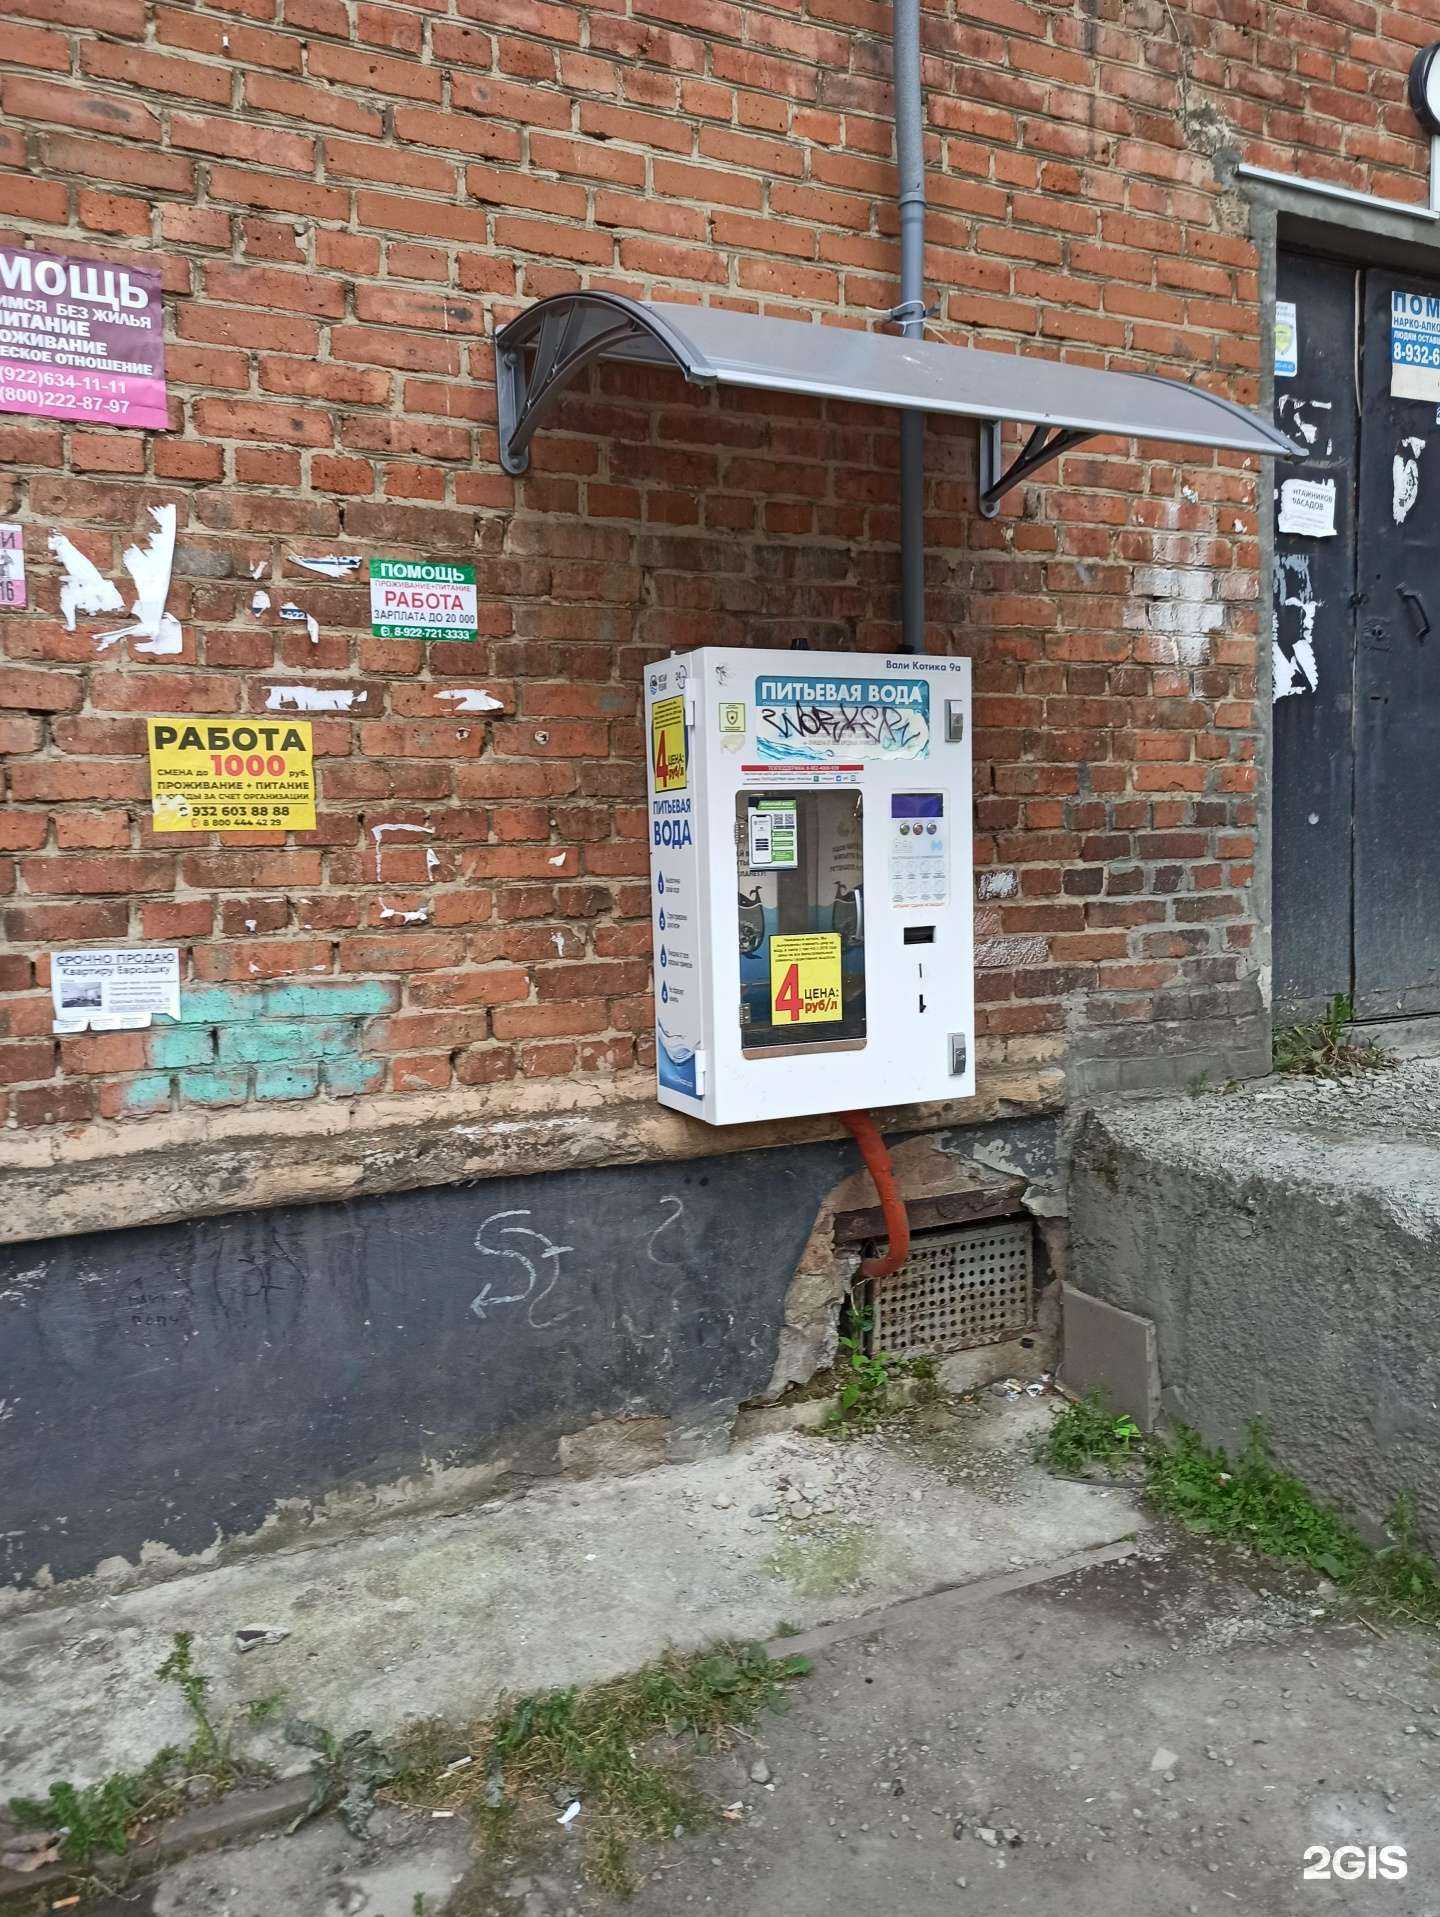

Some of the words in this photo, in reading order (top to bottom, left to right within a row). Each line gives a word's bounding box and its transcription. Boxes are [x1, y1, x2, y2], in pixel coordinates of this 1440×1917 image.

[0, 254, 148, 311] МОЩЬ
[56, 303, 89, 319] БЕЗ
[92, 308, 151, 329] ЖИЛЬЯ
[55, 354, 152, 376] ОТНОШЕНИЕ
[380, 563, 465, 583] ПОМОЩЬ
[385, 590, 464, 610] РАБОТА
[374, 610, 425, 621] ЗАРПЛАТА
[429, 612, 443, 623] ДО
[446, 613, 456, 623] 20
[460, 614, 475, 624] 000
[394, 627, 470, 640] 8-922-721-3333
[886, 660, 910, 671] Вали
[912, 661, 947, 671] Котика
[949, 662, 961, 672] 9а
[762, 682, 861, 702] ПИТЬЕВАЯ
[869, 685, 923, 705] ВОДА
[154, 726, 306, 752] РАБОТА
[157, 768, 193, 777] СМЕНА
[196, 769, 208, 777] до
[210, 754, 286, 777] 1000
[289, 769, 309, 778] руб.
[656, 729, 669, 788] 4
[157, 781, 243, 790] ПРОЖИВАНИЕ
[255, 782, 309, 790] ПИТАНИЕ
[243, 793, 310, 801] ОРГАНИЗАЦИИ
[192, 806, 217, 817] 932
[222, 806, 247, 817] 603
[251, 806, 268, 817] 88
[272, 807, 289, 817] 88
[653, 798, 691, 815] ПИТЬЕВАЯ
[654, 819, 692, 849] ВОДА
[56, 955, 112, 965] СРОЧНО
[116, 953, 175, 964] ПРОДАЮ
[62, 967, 113, 977] Квартиру
[775, 963, 804, 1021] 4
[804, 987, 839, 1000] ЦЕНА:
[804, 998, 838, 1013] руб/л
